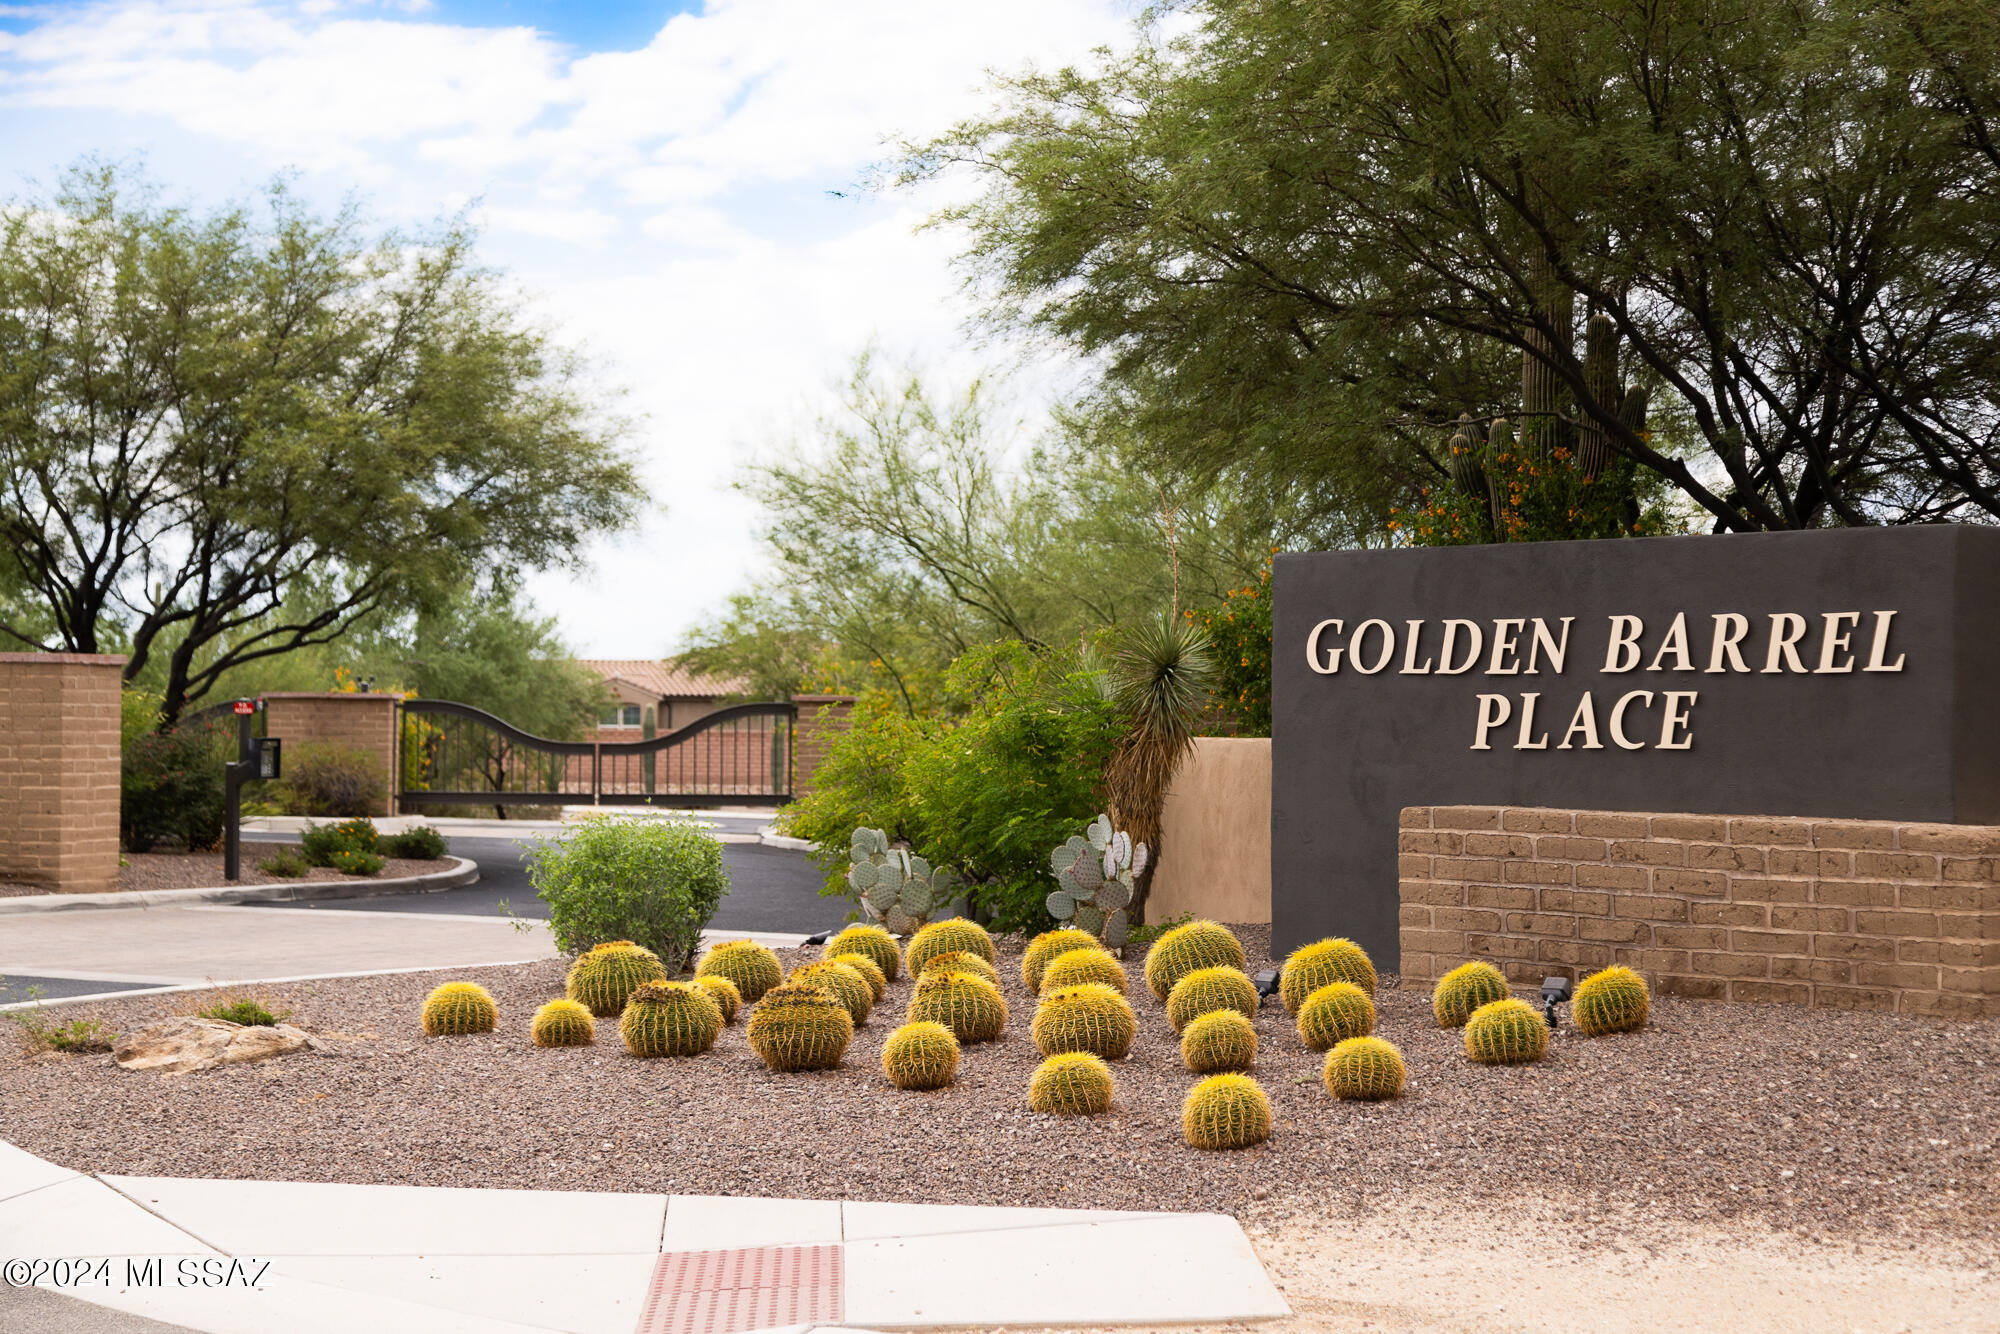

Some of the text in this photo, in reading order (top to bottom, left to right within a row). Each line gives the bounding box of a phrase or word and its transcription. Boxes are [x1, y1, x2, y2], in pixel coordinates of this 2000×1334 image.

[1307, 611, 1905, 674] GOLDEN BARREL
[1470, 690, 1697, 750] PLACE
